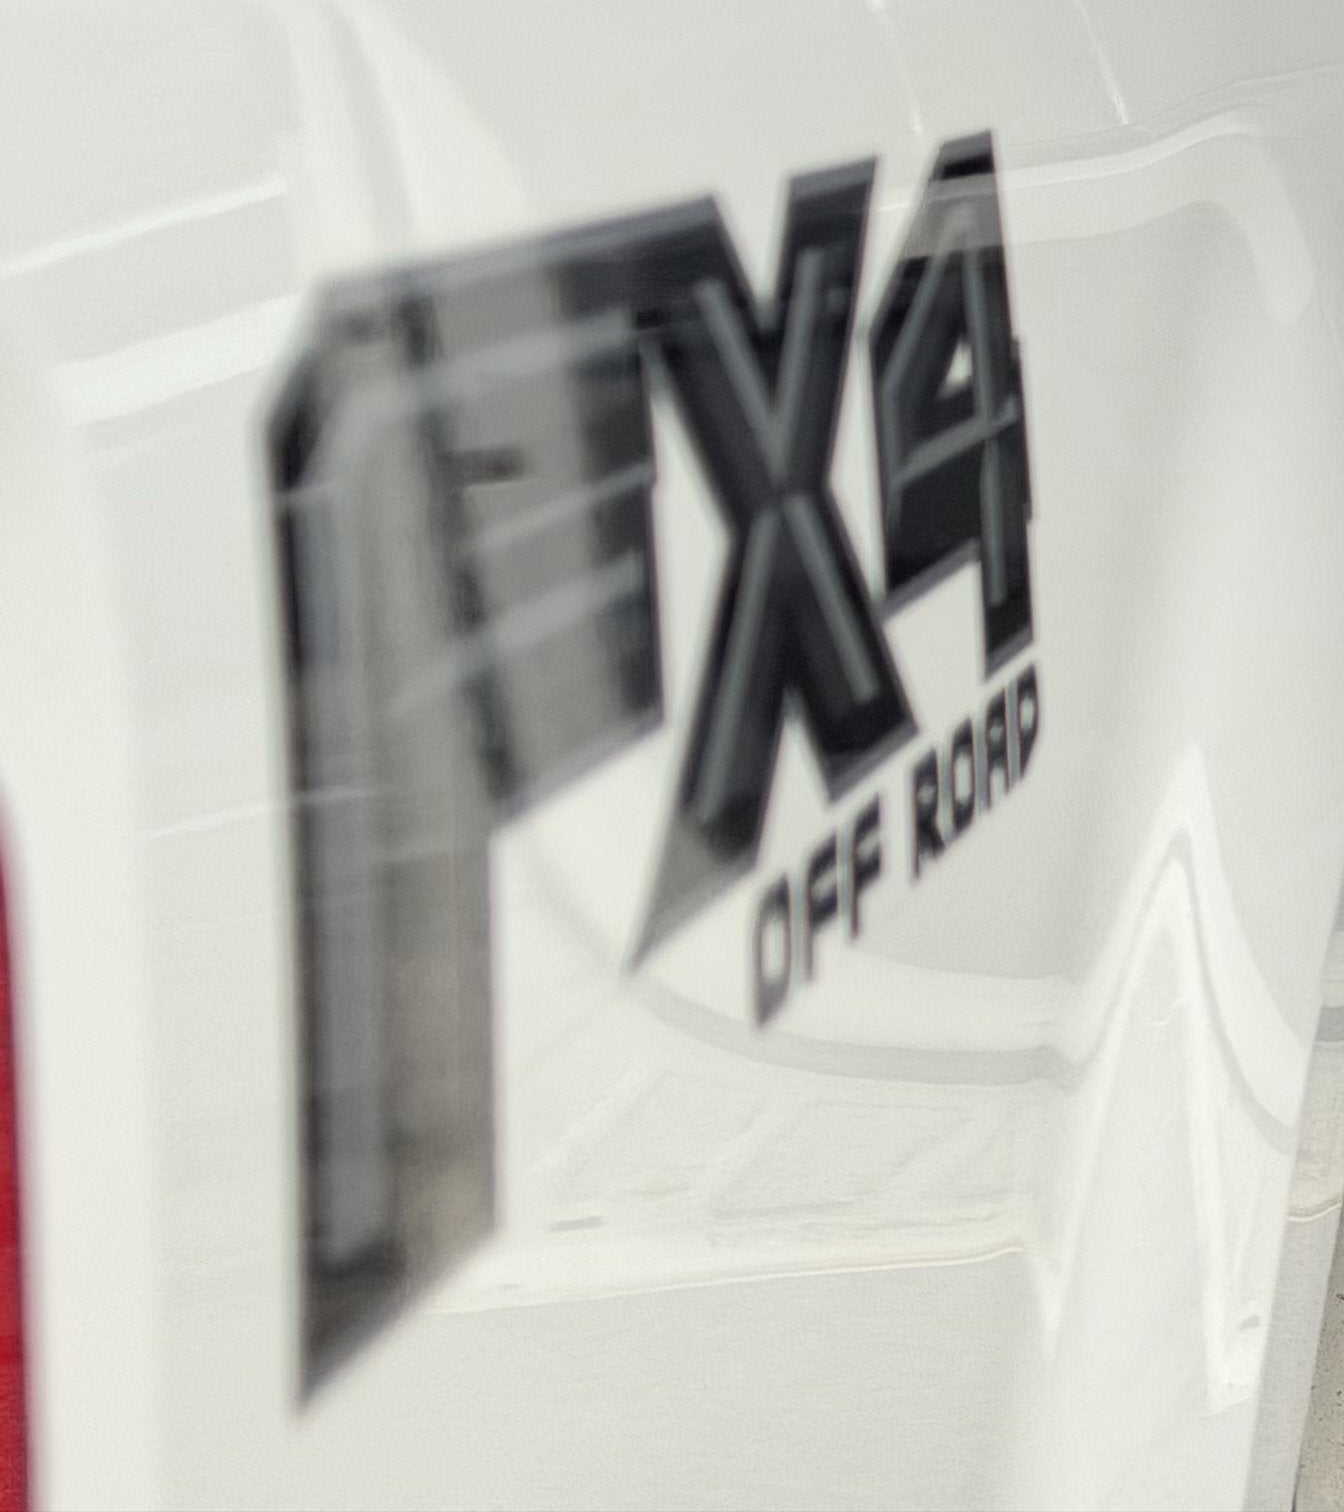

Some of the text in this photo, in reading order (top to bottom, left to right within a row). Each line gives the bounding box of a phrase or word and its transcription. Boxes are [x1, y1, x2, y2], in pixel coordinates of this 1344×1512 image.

[262, 129, 1036, 1416] FX4
[754, 662, 1039, 1028] OFF ROAD
